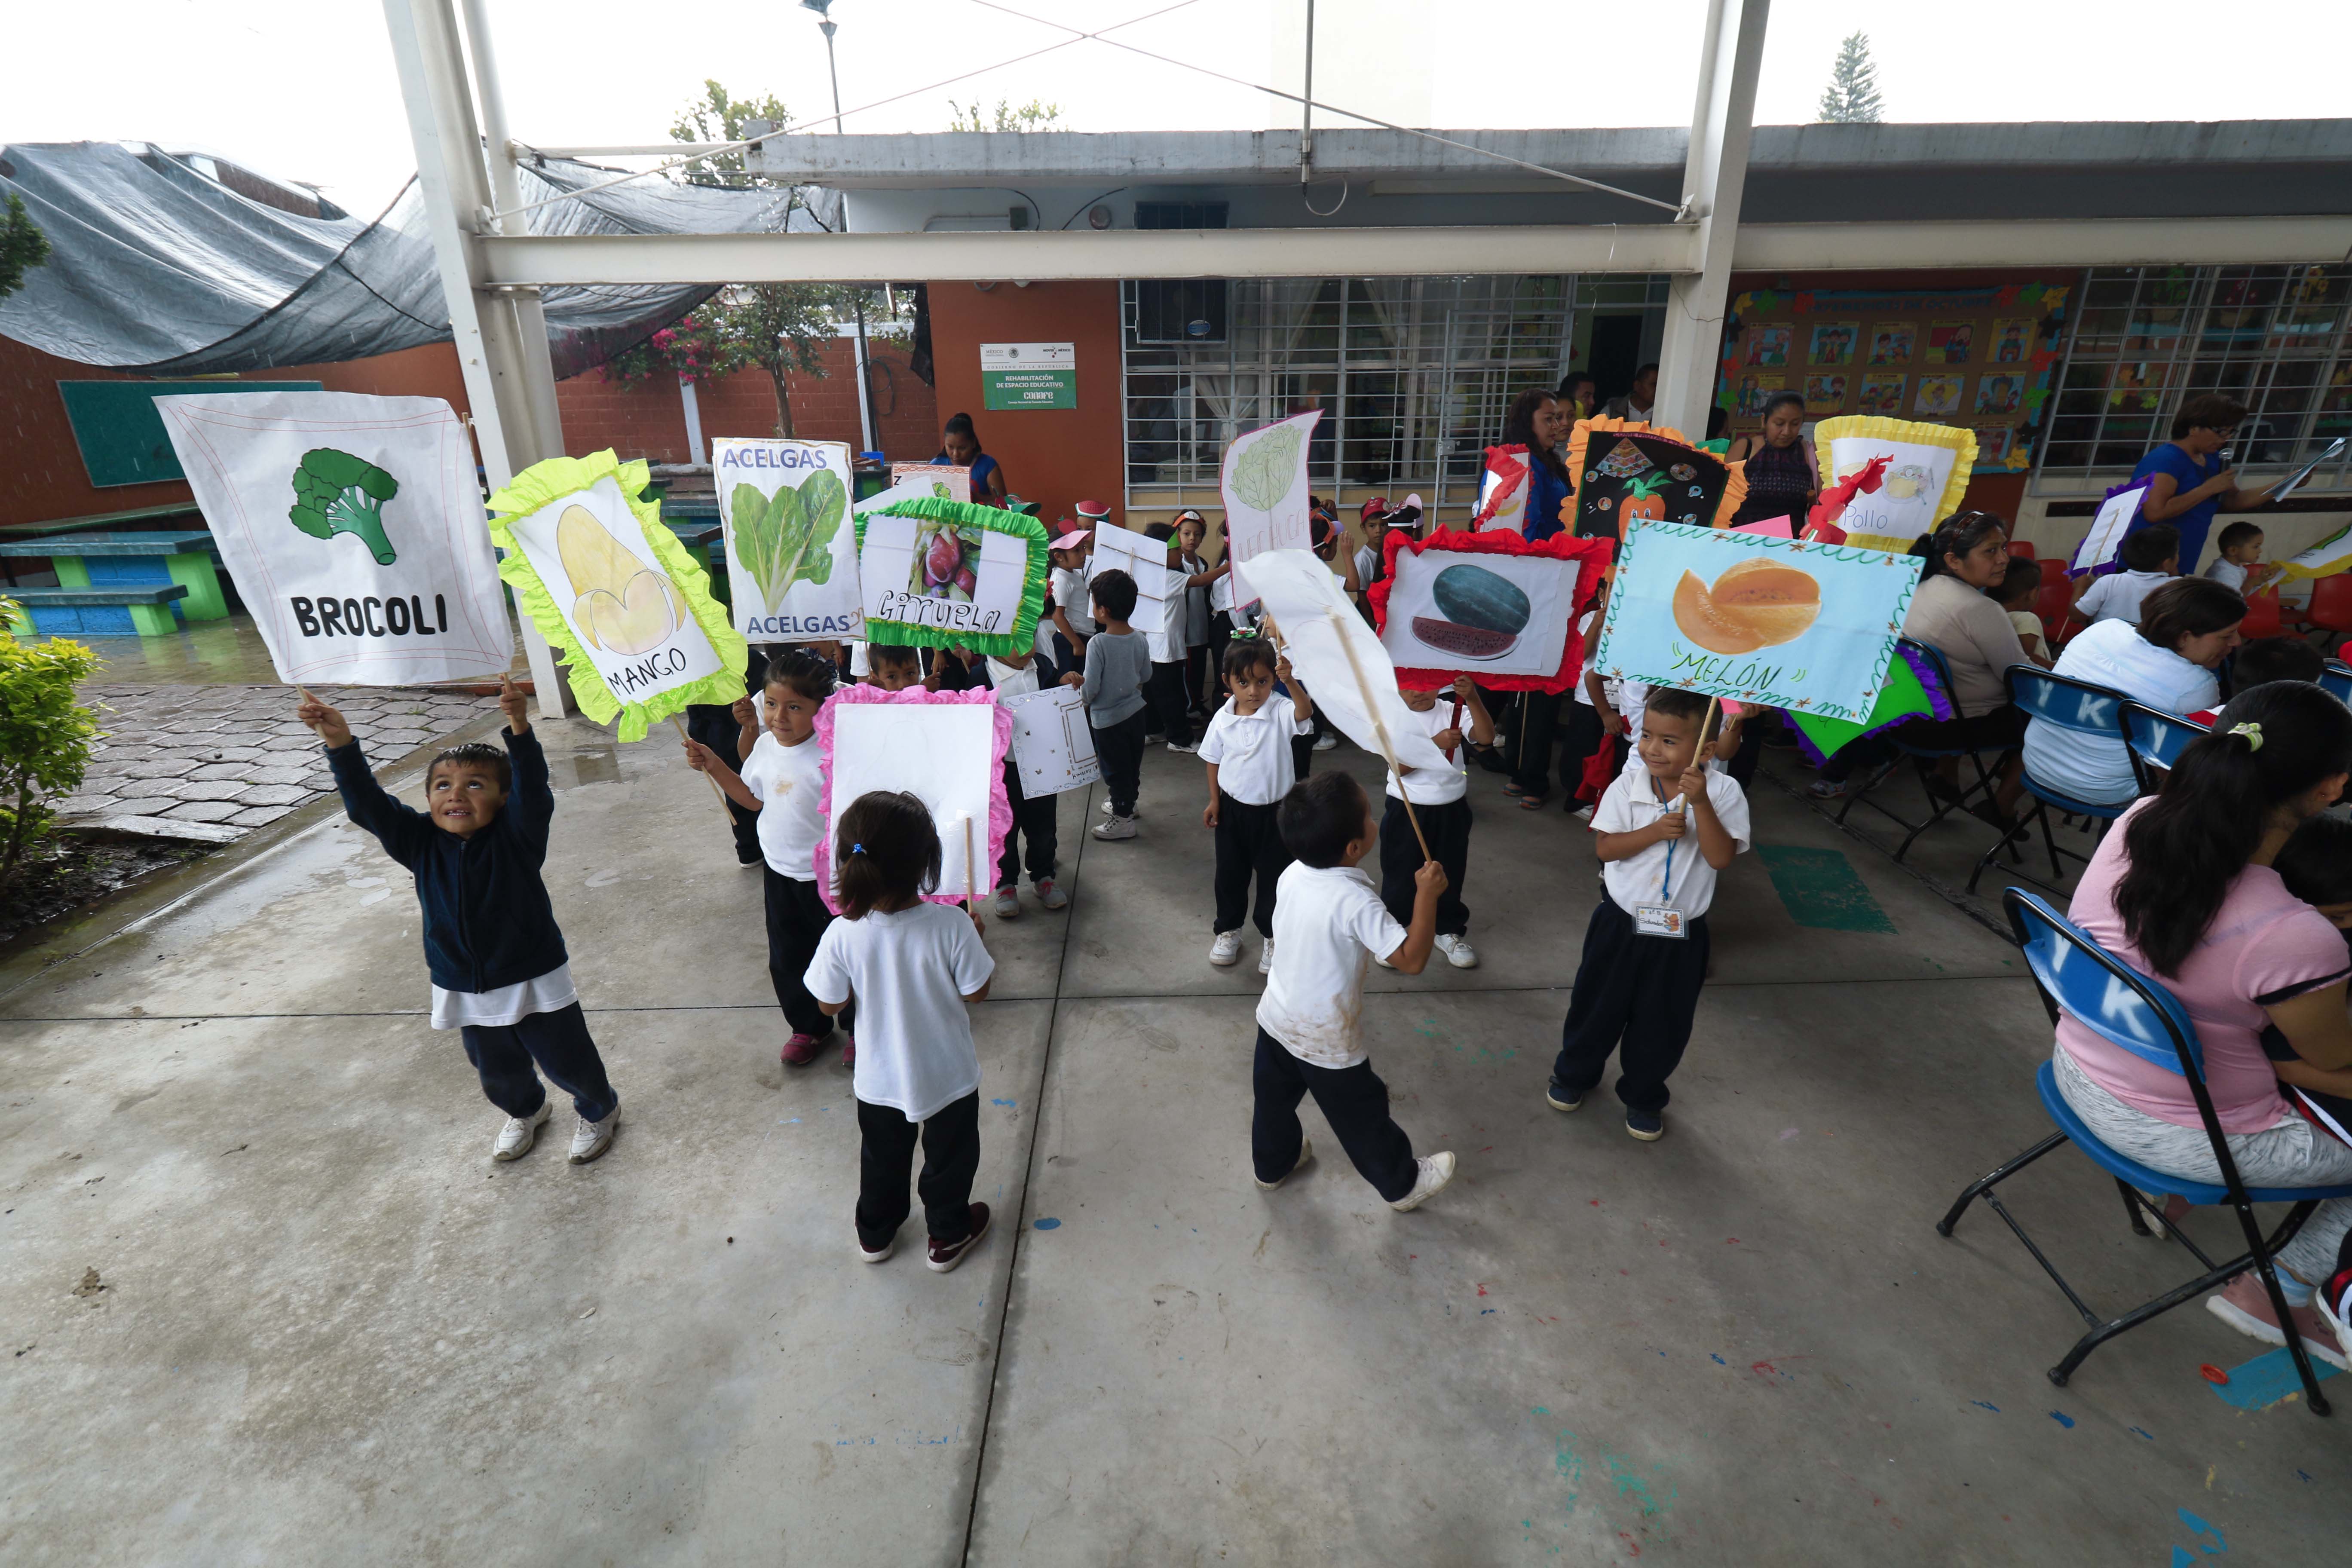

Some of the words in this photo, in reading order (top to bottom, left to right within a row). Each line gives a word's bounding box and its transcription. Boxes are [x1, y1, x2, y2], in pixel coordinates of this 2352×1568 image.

[723, 448, 827, 469] ACELGAS
[1844, 505, 1887, 529] Pollo
[291, 594, 447, 637] BROCOLI
[747, 615, 850, 634] ACELGAS
[607, 648, 686, 695] MANGO
[2076, 693, 2112, 728] K
